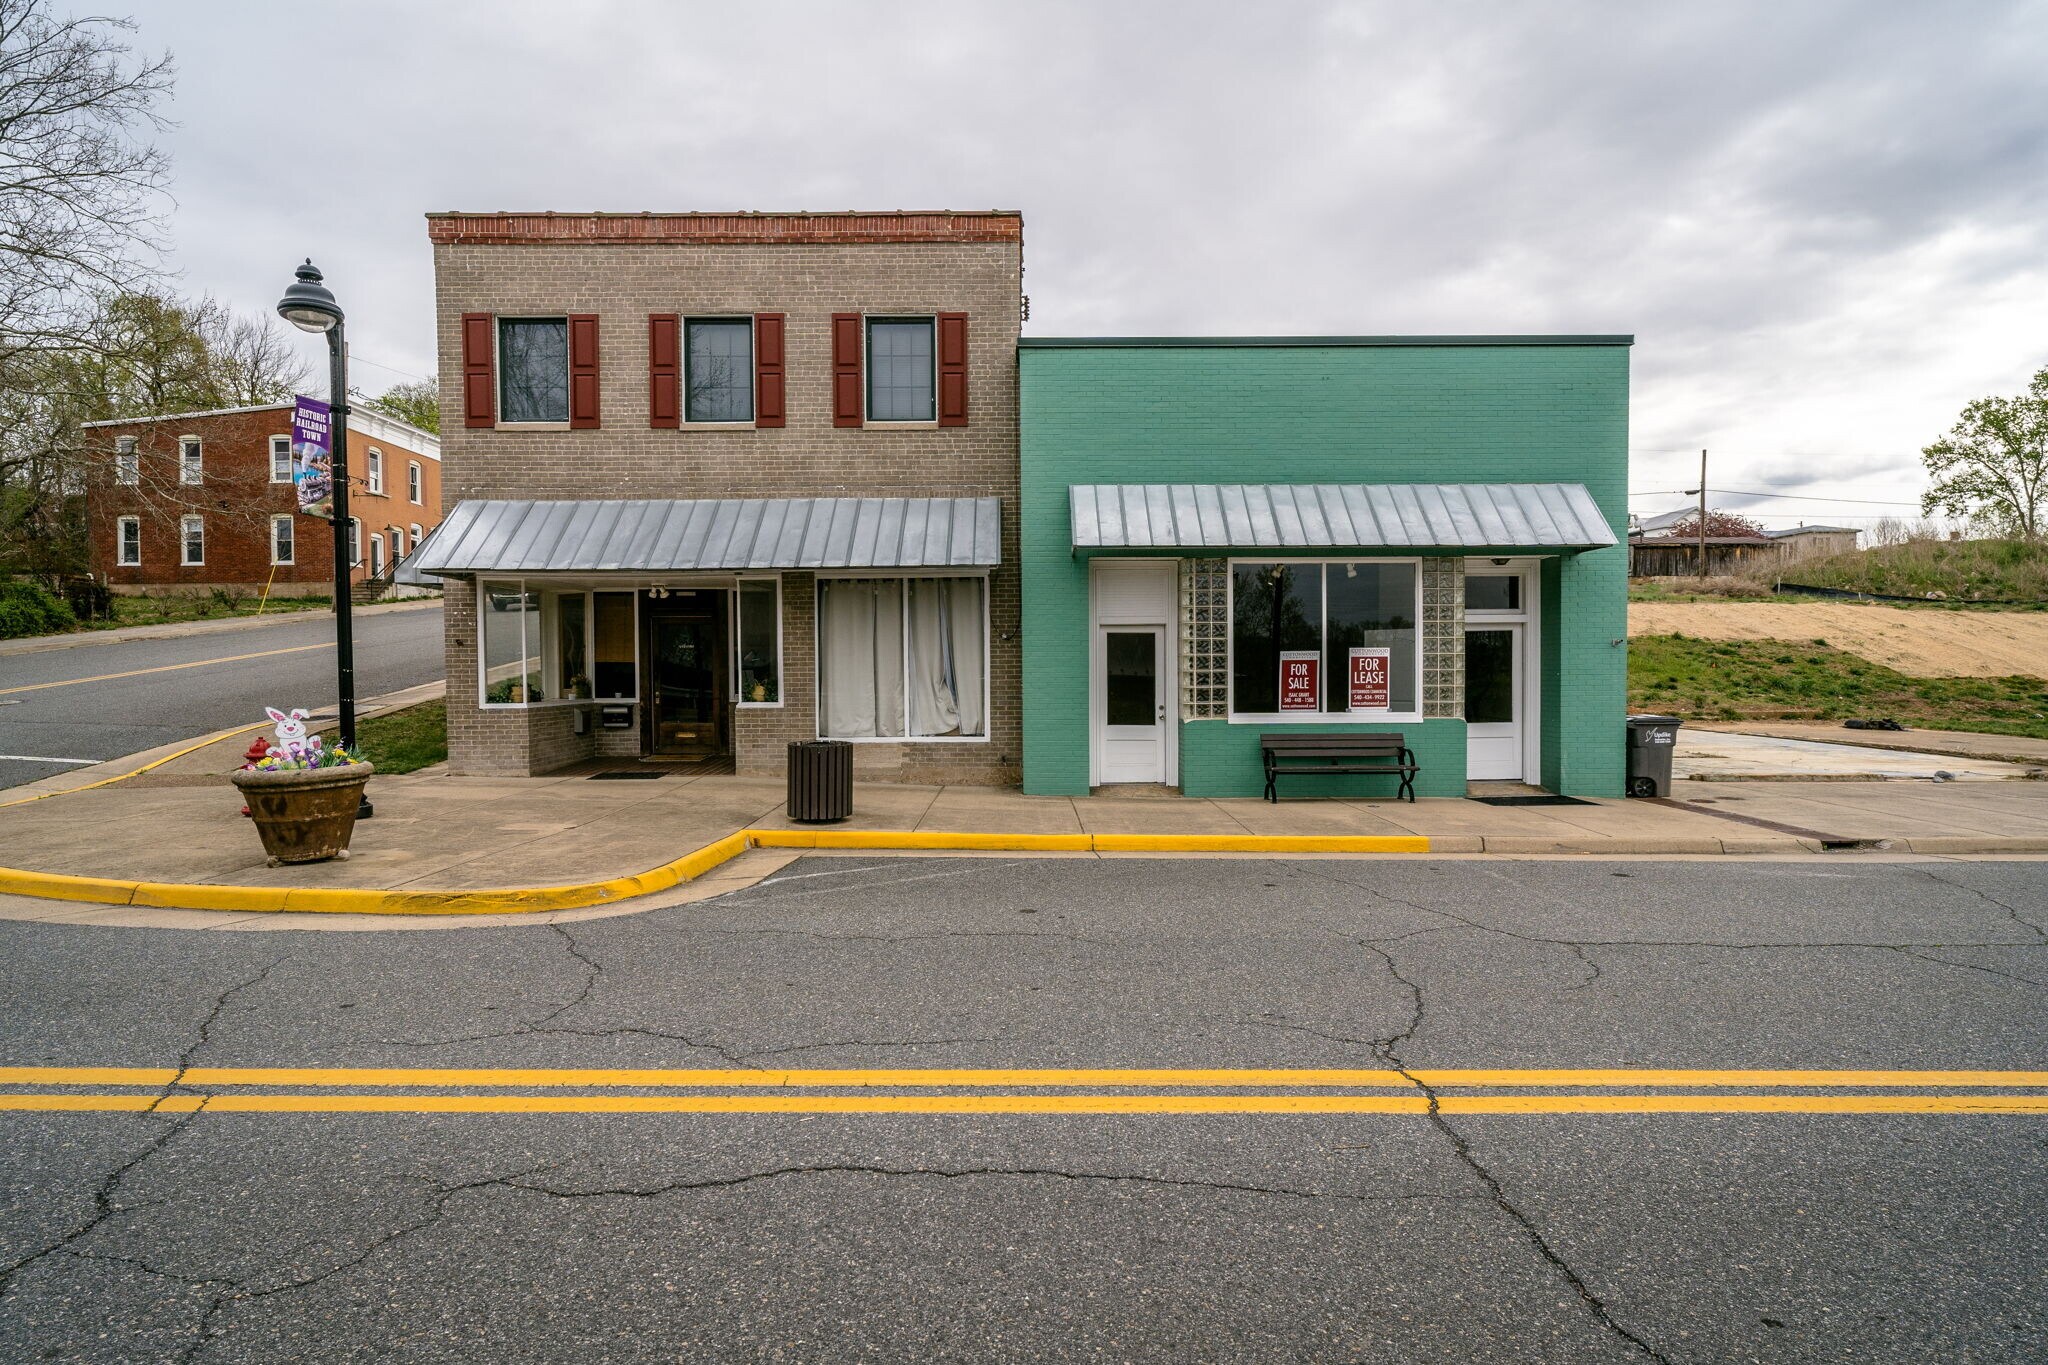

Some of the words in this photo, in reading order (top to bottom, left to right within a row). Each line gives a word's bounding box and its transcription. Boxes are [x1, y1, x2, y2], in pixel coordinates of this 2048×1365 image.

[298, 408, 326, 423] HISTORIC
[296, 417, 327, 433] RAILROAD
[302, 429, 321, 442] TOWN
[1290, 664, 1308, 676] FOR
[1359, 658, 1379, 671] FOR
[1288, 677, 1310, 689] SALE
[1354, 671, 1385, 684] LEASE
